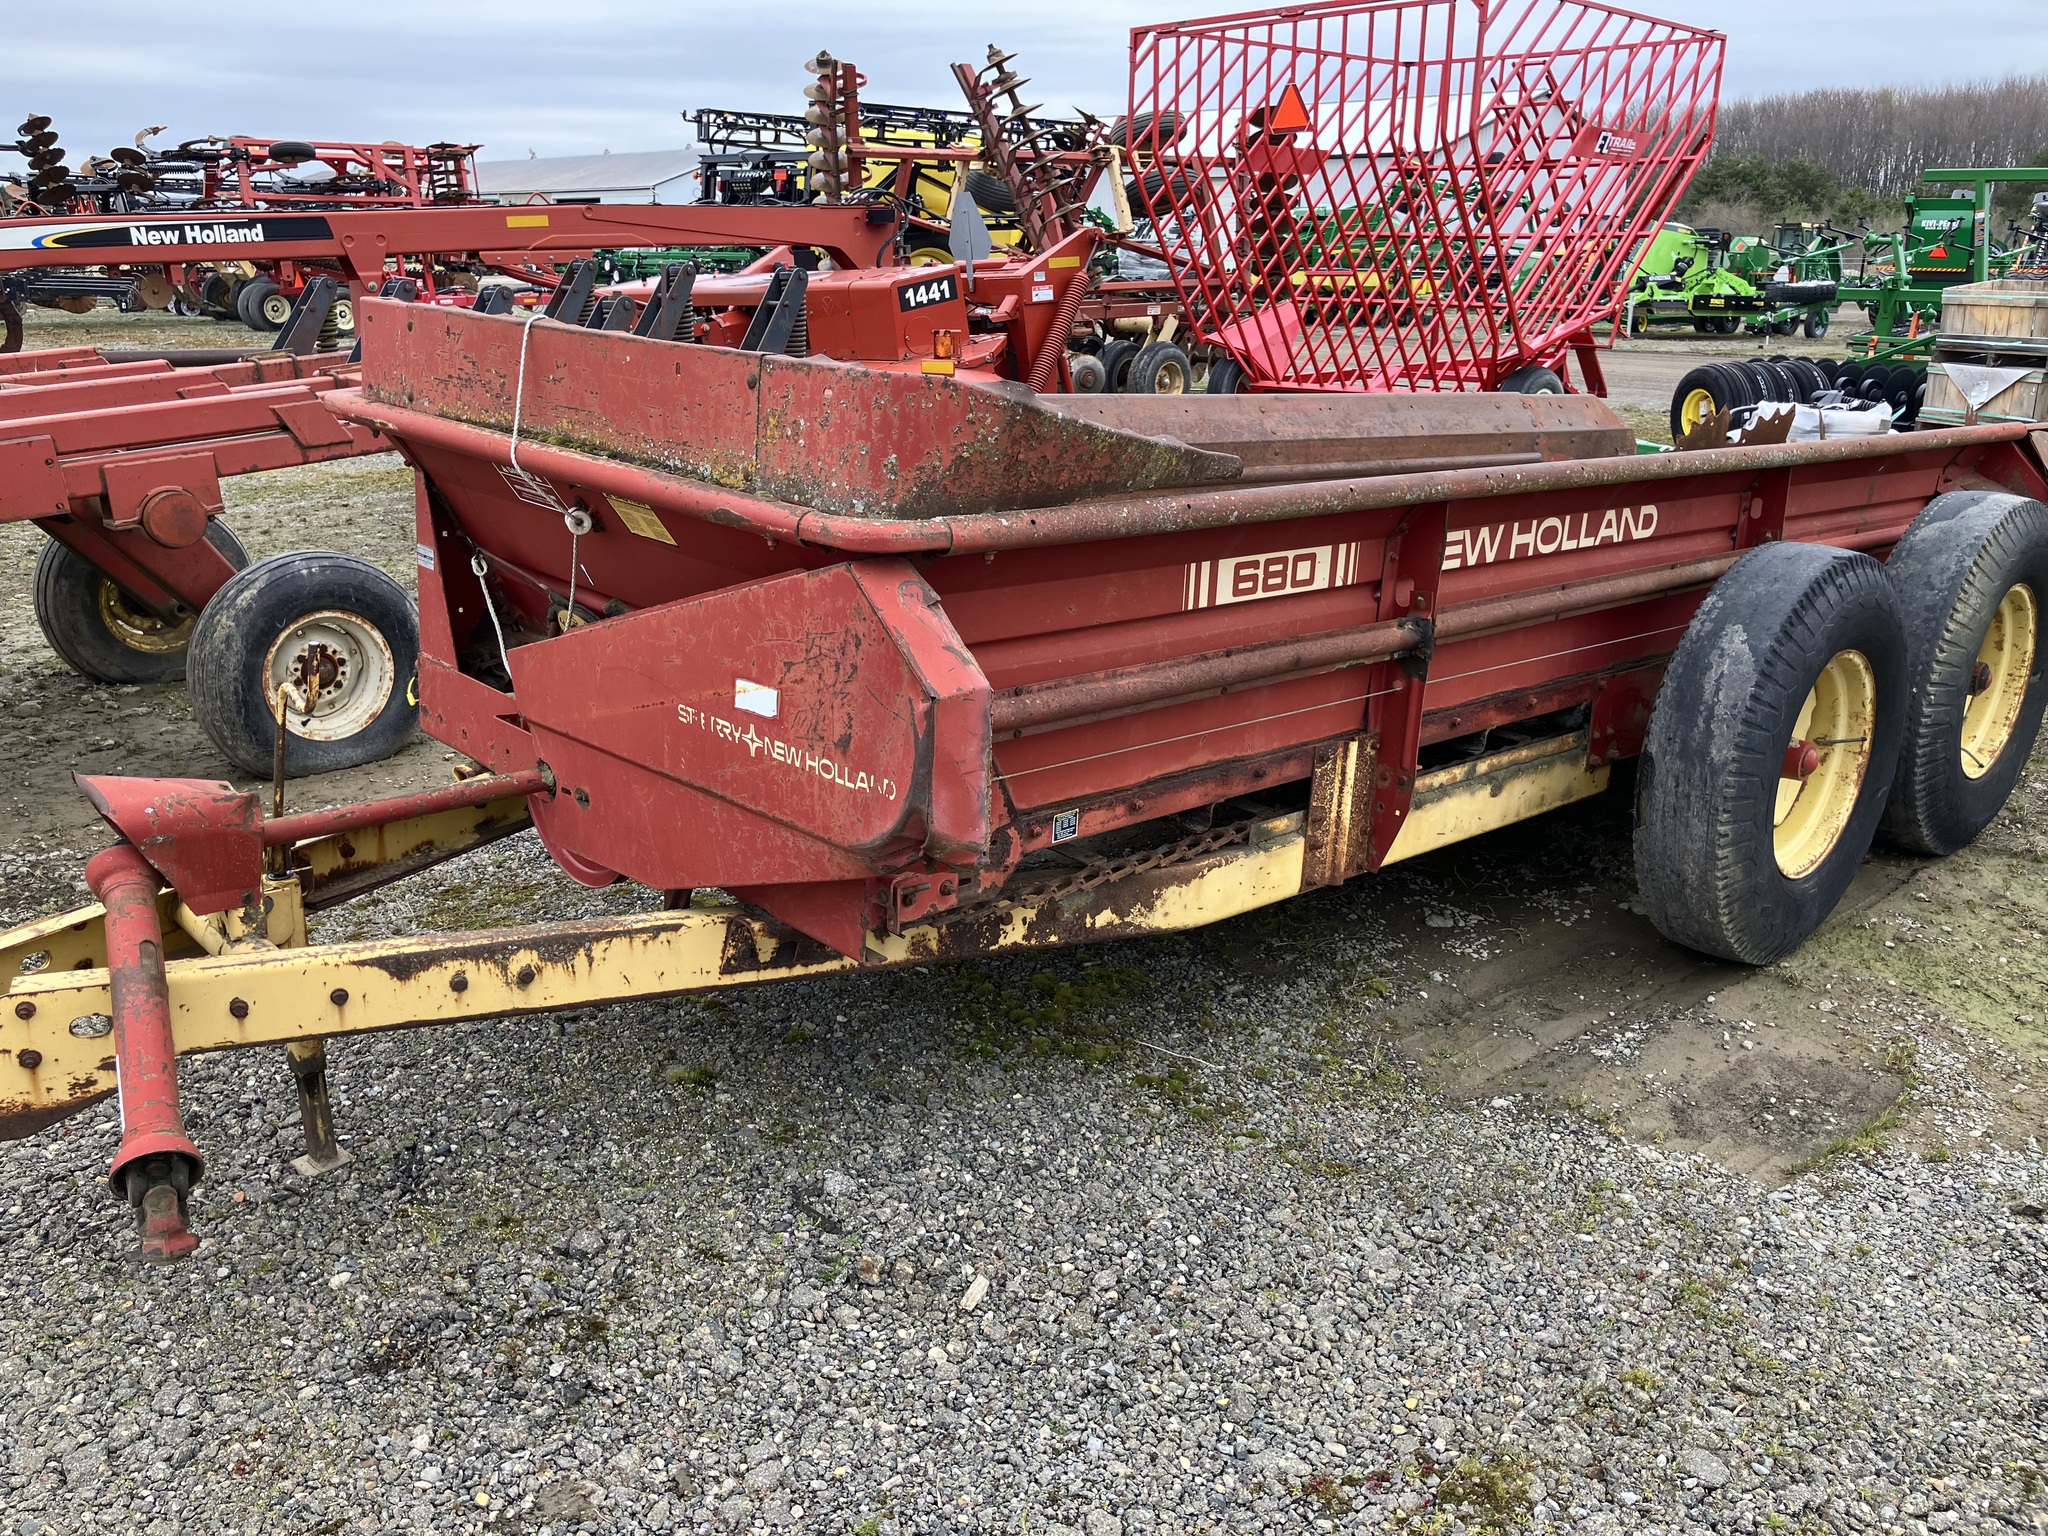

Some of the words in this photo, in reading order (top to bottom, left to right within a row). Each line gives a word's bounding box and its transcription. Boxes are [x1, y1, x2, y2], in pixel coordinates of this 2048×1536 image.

[1609, 136, 1636, 149] TRAIL
[129, 226, 180, 246] New
[184, 223, 265, 244] Holland
[905, 279, 950, 307] 1441
[1441, 524, 1505, 571] EW
[1509, 504, 1659, 560] HOLLAND
[1232, 552, 1317, 598] 680
[764, 736, 801, 768] NEW
